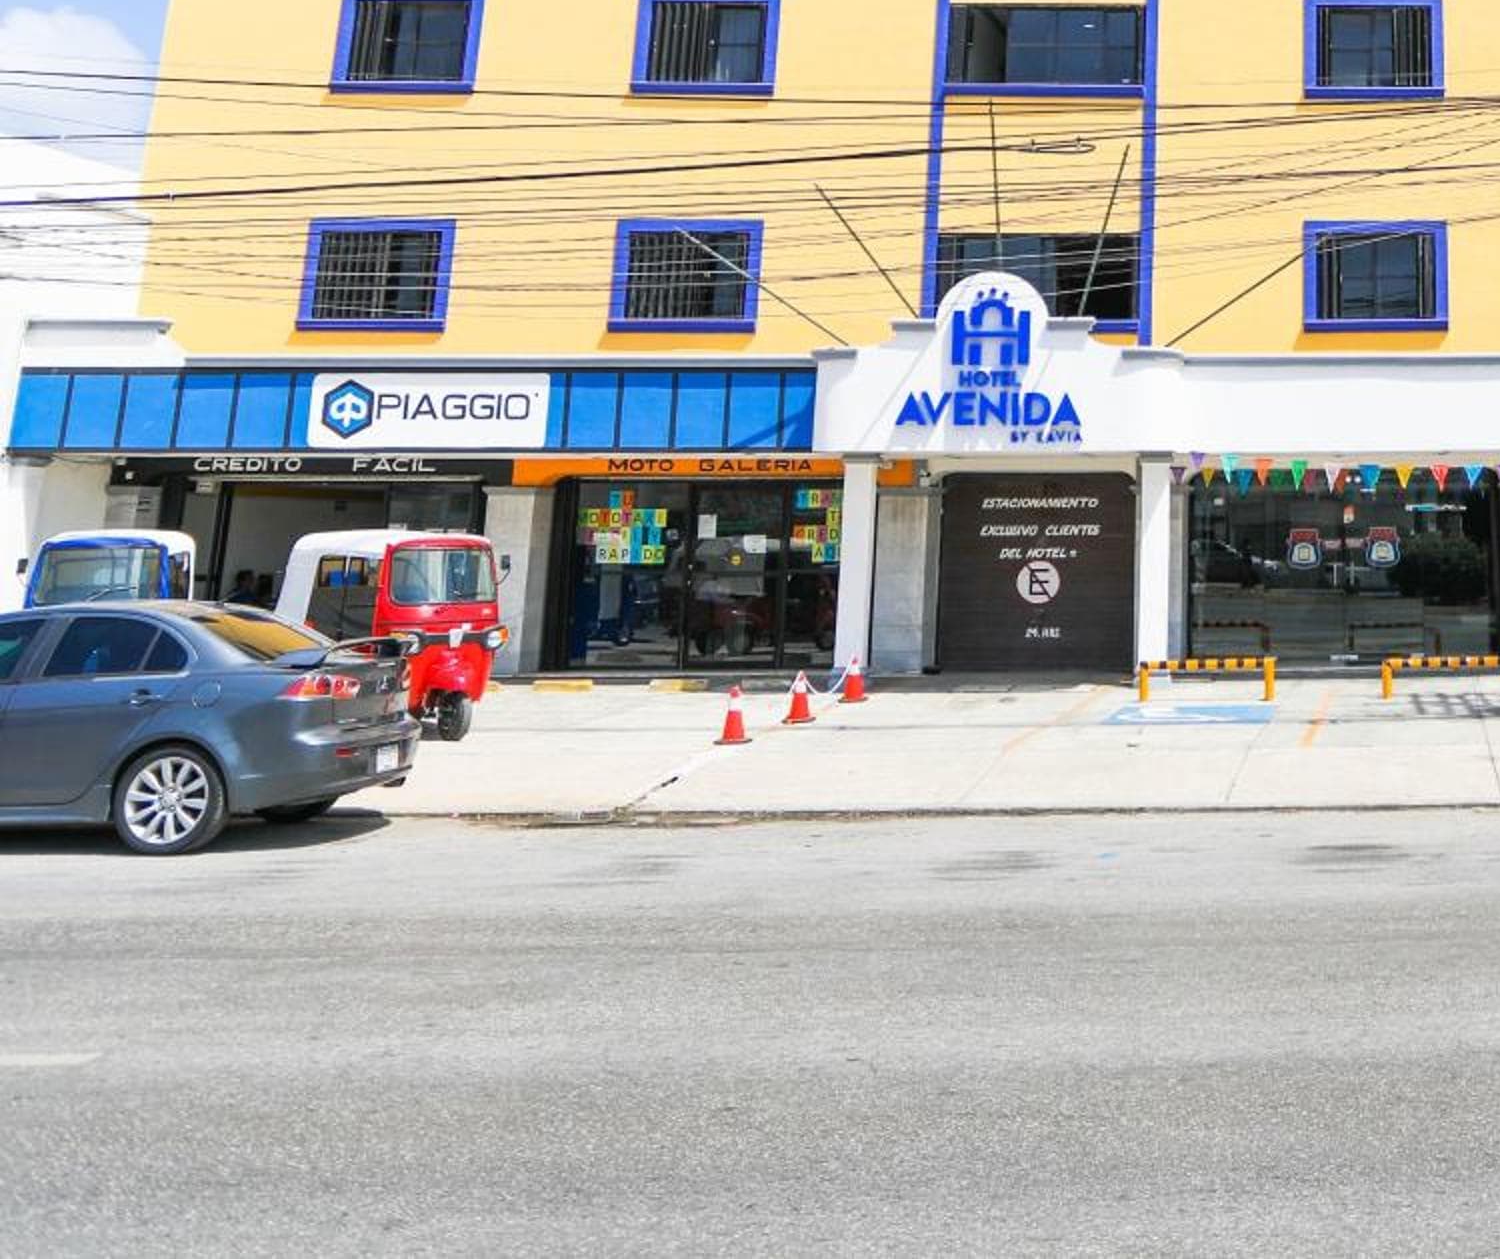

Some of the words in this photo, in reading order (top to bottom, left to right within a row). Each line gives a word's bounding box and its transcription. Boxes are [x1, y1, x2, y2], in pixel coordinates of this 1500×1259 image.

[958, 370, 1021, 387] HOTEL
[376, 393, 531, 421] PIAGGIO
[895, 391, 1082, 426] AVENIDA
[194, 457, 303, 472] CREDITO
[352, 457, 436, 472] FACIL
[608, 458, 675, 472] MOTO
[699, 458, 813, 472] GALERIA
[981, 497, 1100, 509] ESTACIONAMIENTO
[980, 524, 1039, 537] EXCLUSIVO
[1045, 524, 1102, 537] CLIENTES
[1000, 547, 1023, 560] DEL
[1026, 547, 1067, 559] HOTEL
